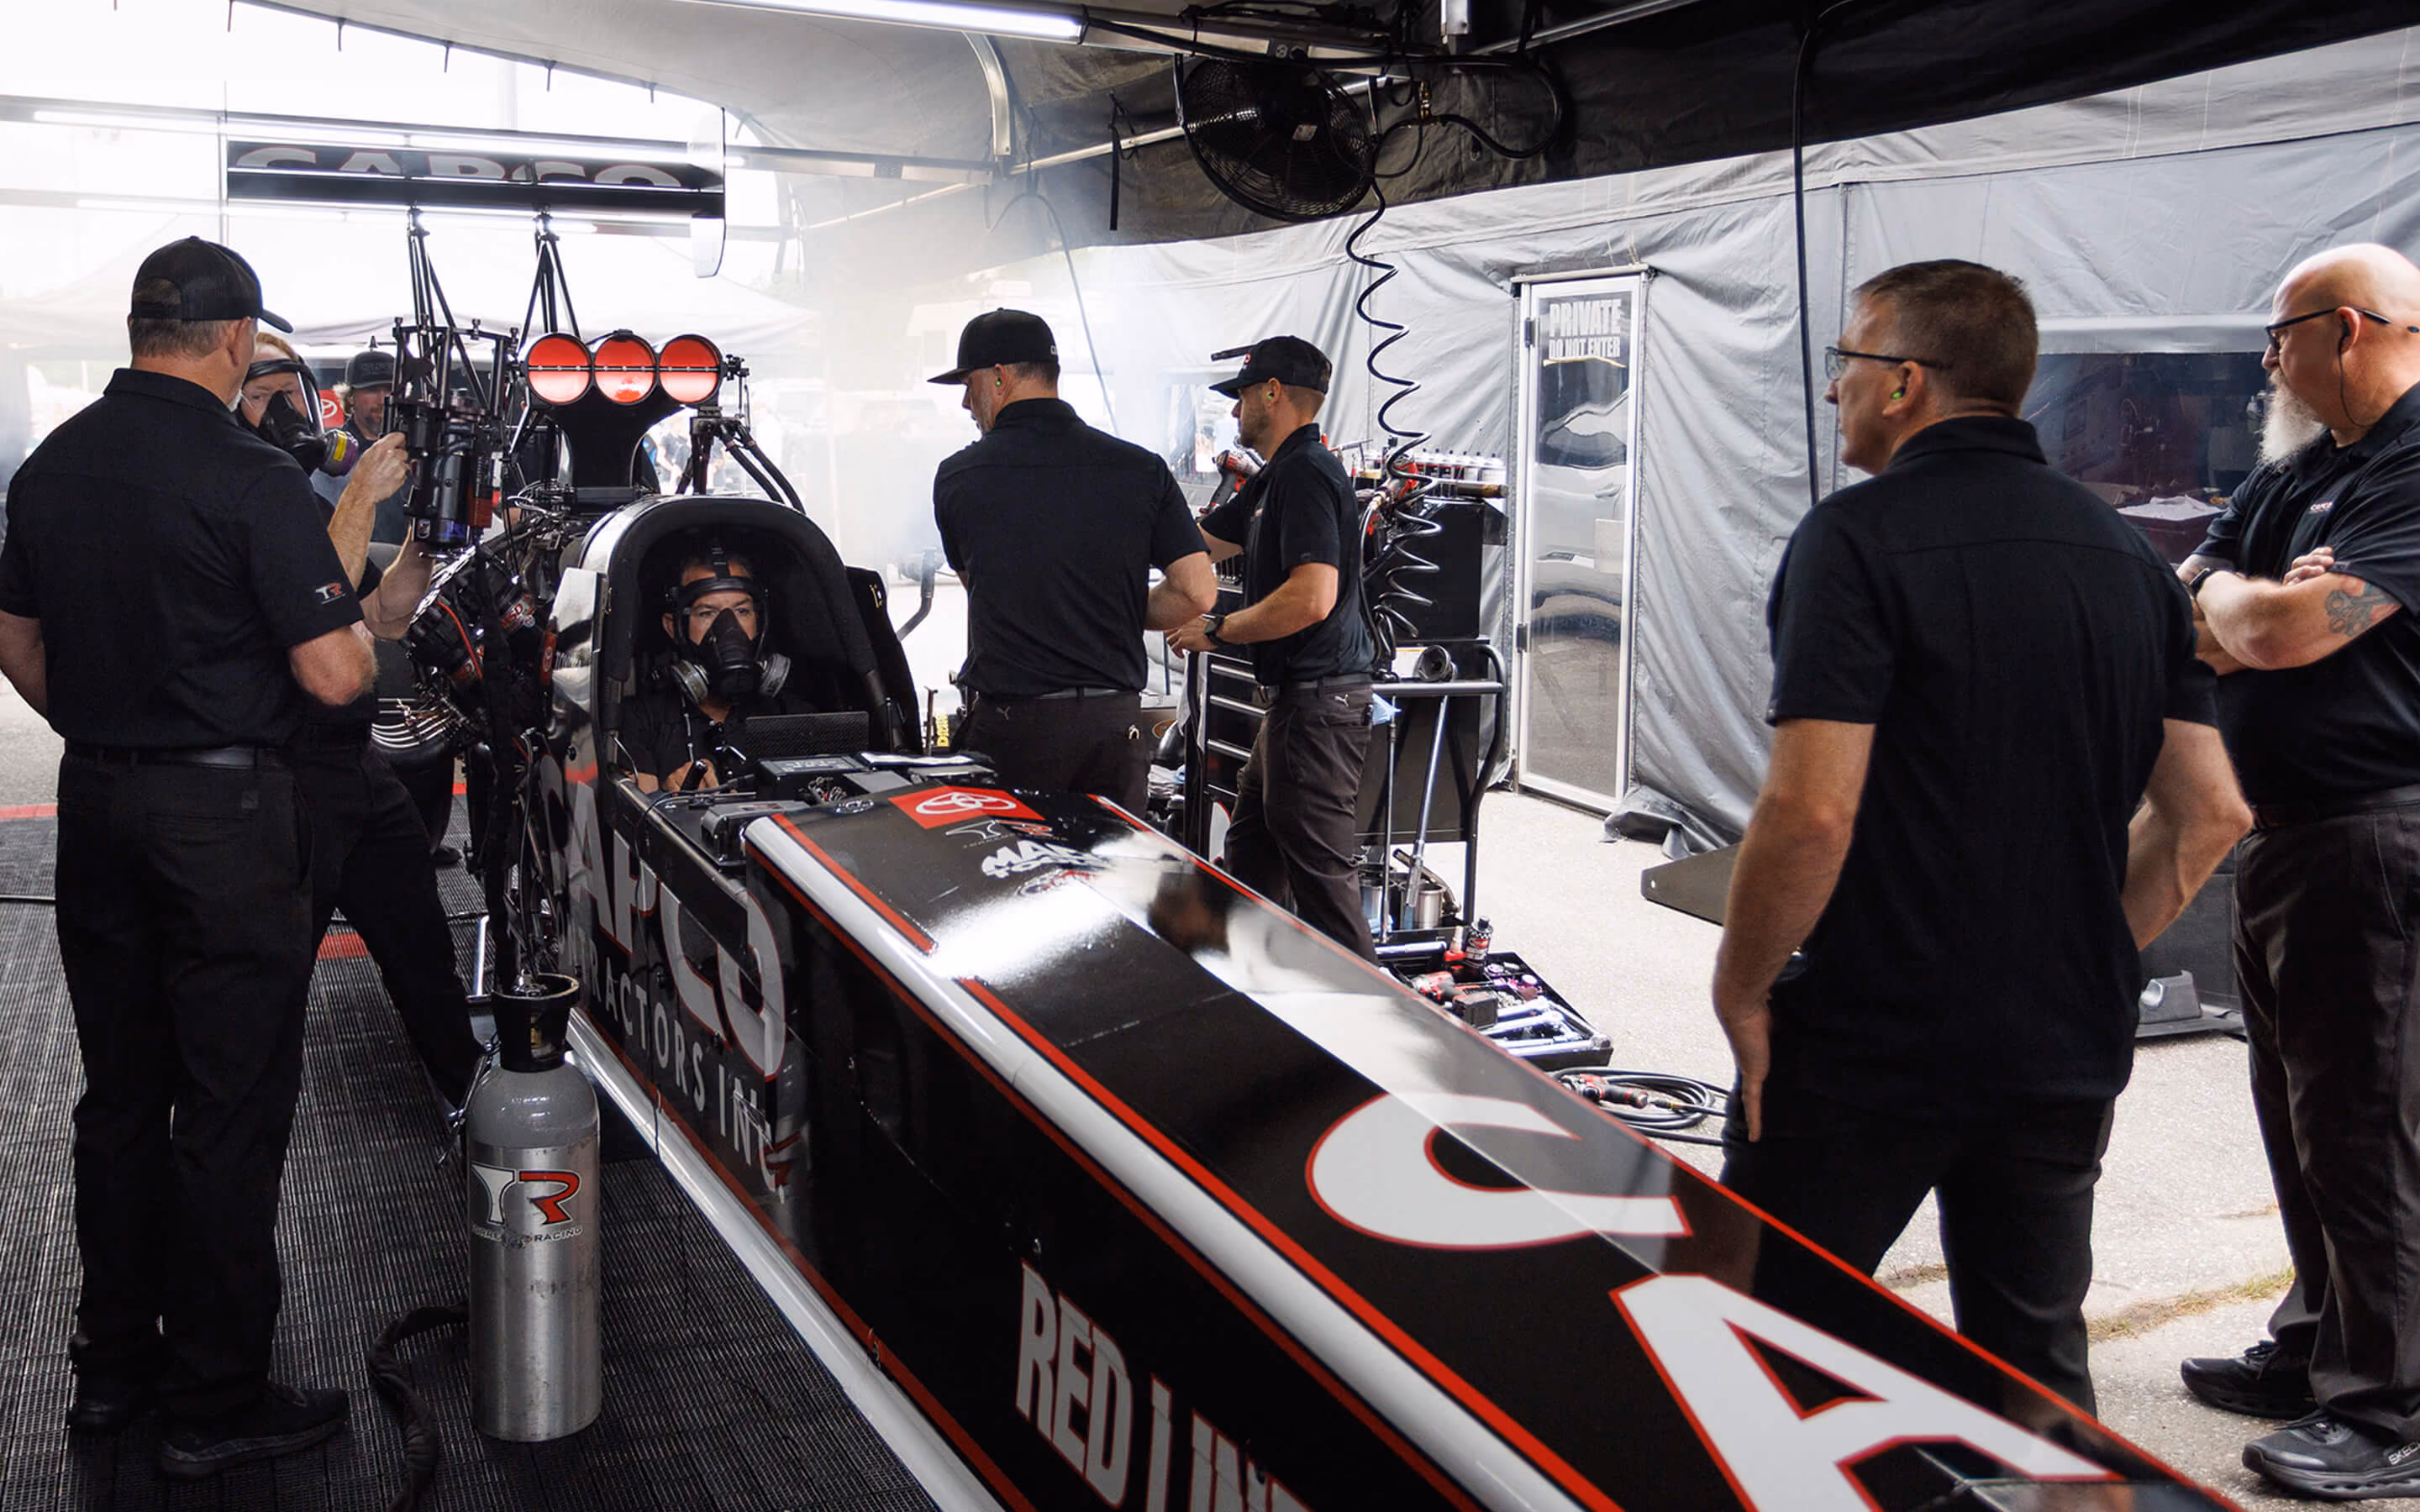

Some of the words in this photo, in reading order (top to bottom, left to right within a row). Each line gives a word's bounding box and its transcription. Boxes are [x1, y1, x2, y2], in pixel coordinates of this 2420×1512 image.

[1549, 299, 1621, 337] PRIVATE
[1565, 338, 1586, 357] NOT
[1587, 336, 1620, 357] ENTER
[533, 1226, 583, 1242] RACING
[1015, 1258, 1134, 1509] RED
[2388, 1442, 2420, 1465] SKEC
